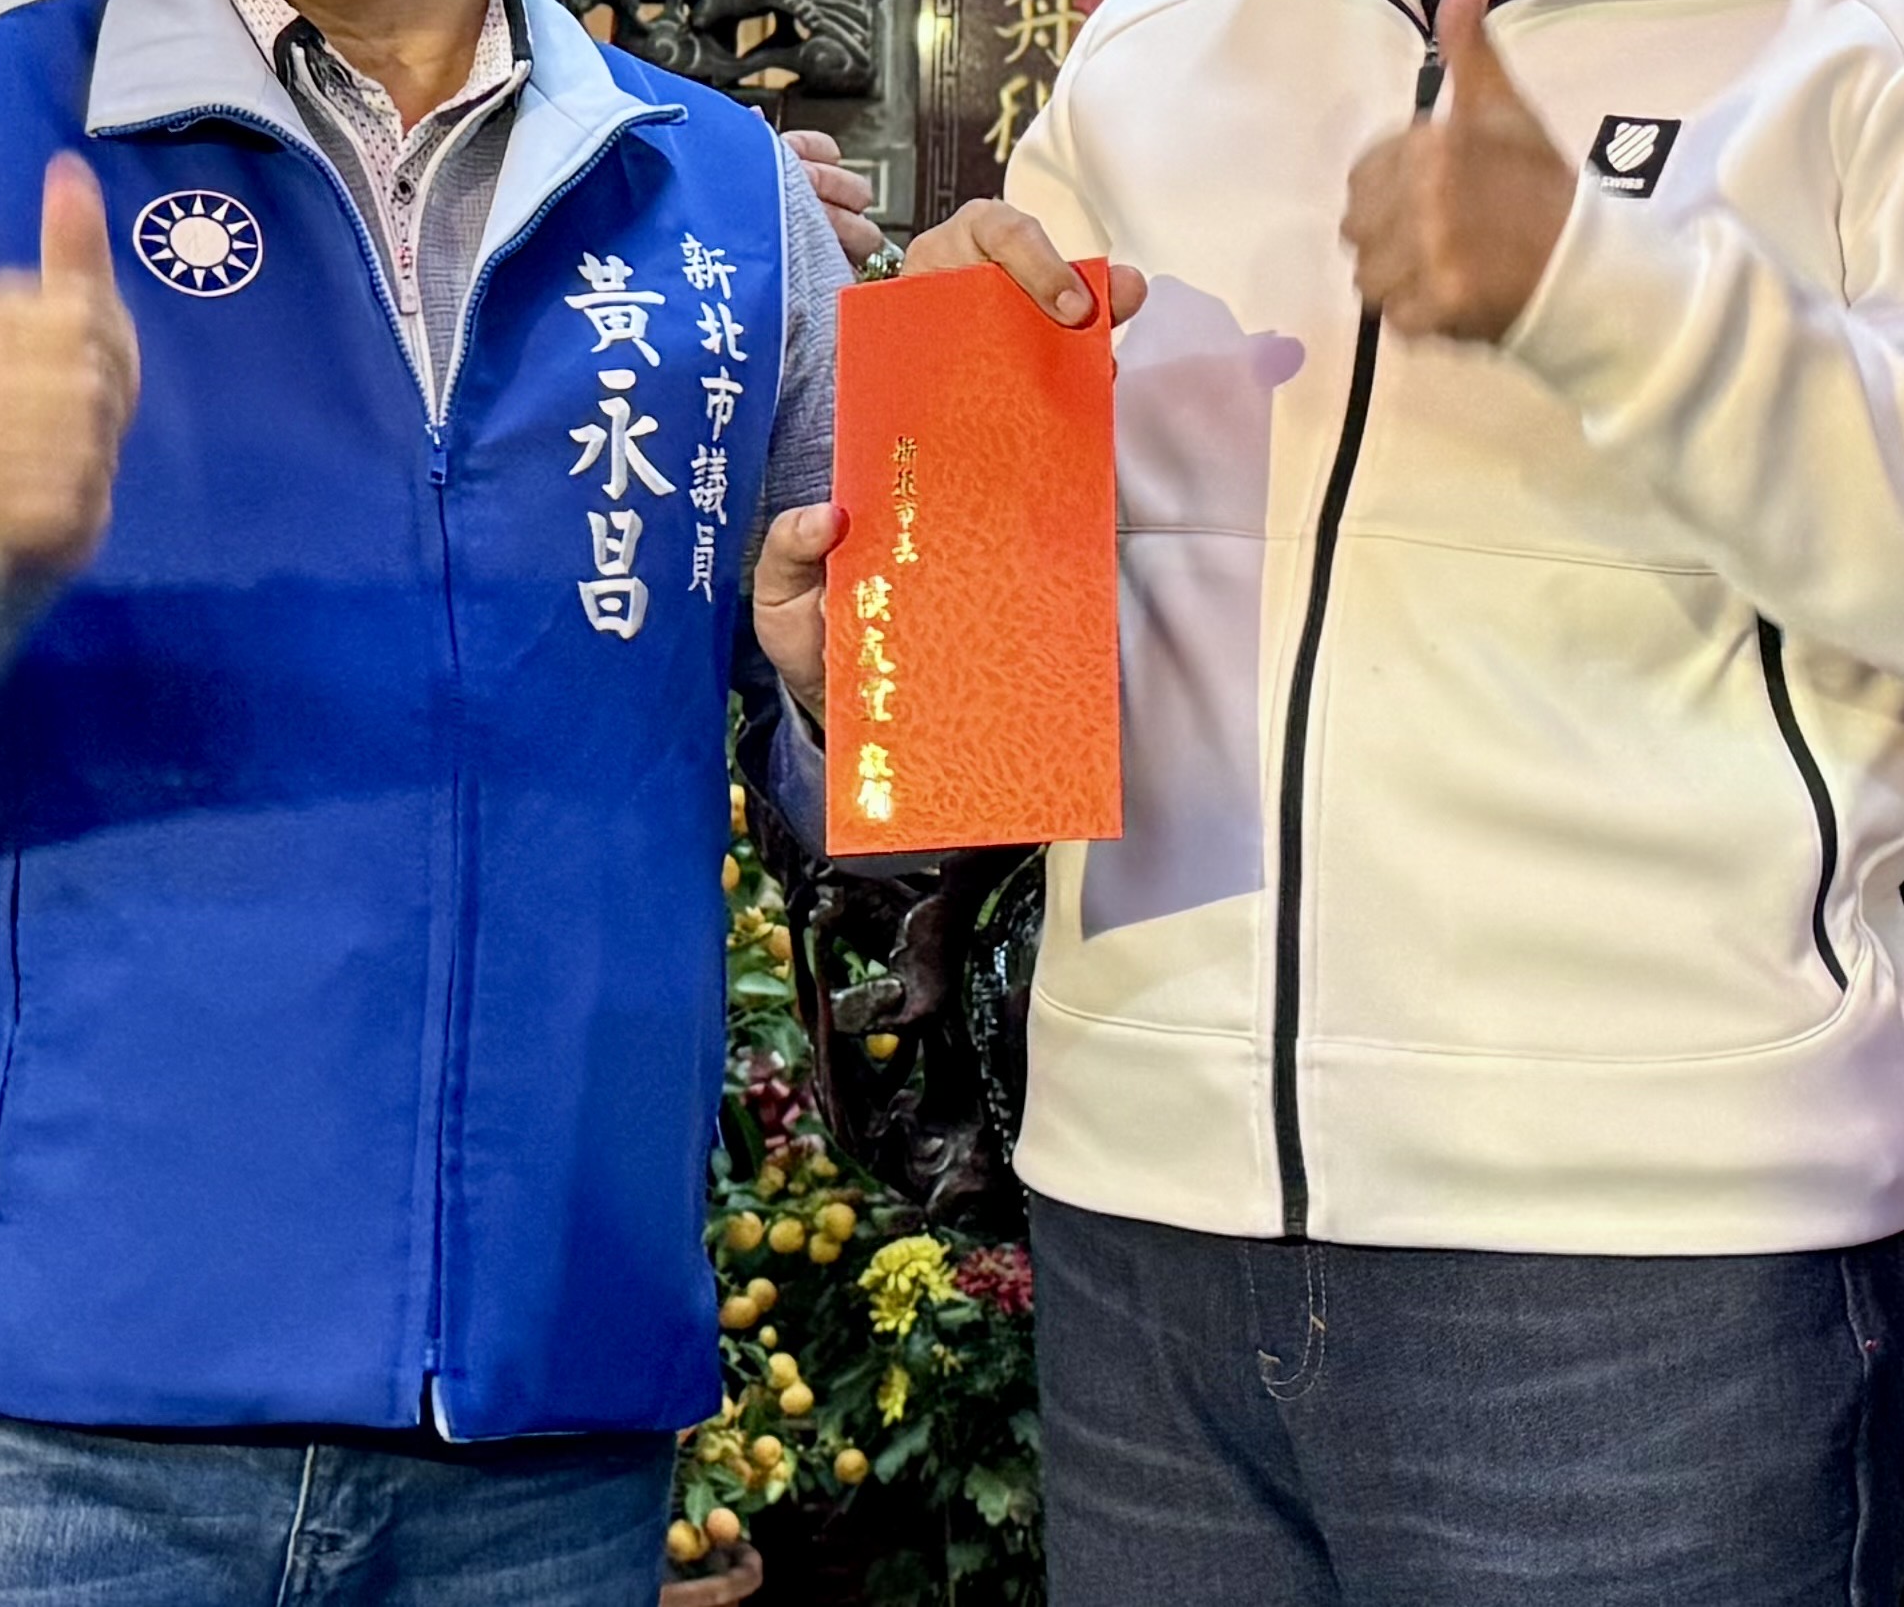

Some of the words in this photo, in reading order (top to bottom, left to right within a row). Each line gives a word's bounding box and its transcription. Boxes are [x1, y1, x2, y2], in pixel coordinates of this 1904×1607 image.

[564, 251, 677, 641] 黃永昌
[679, 231, 749, 603] 新北市議員
